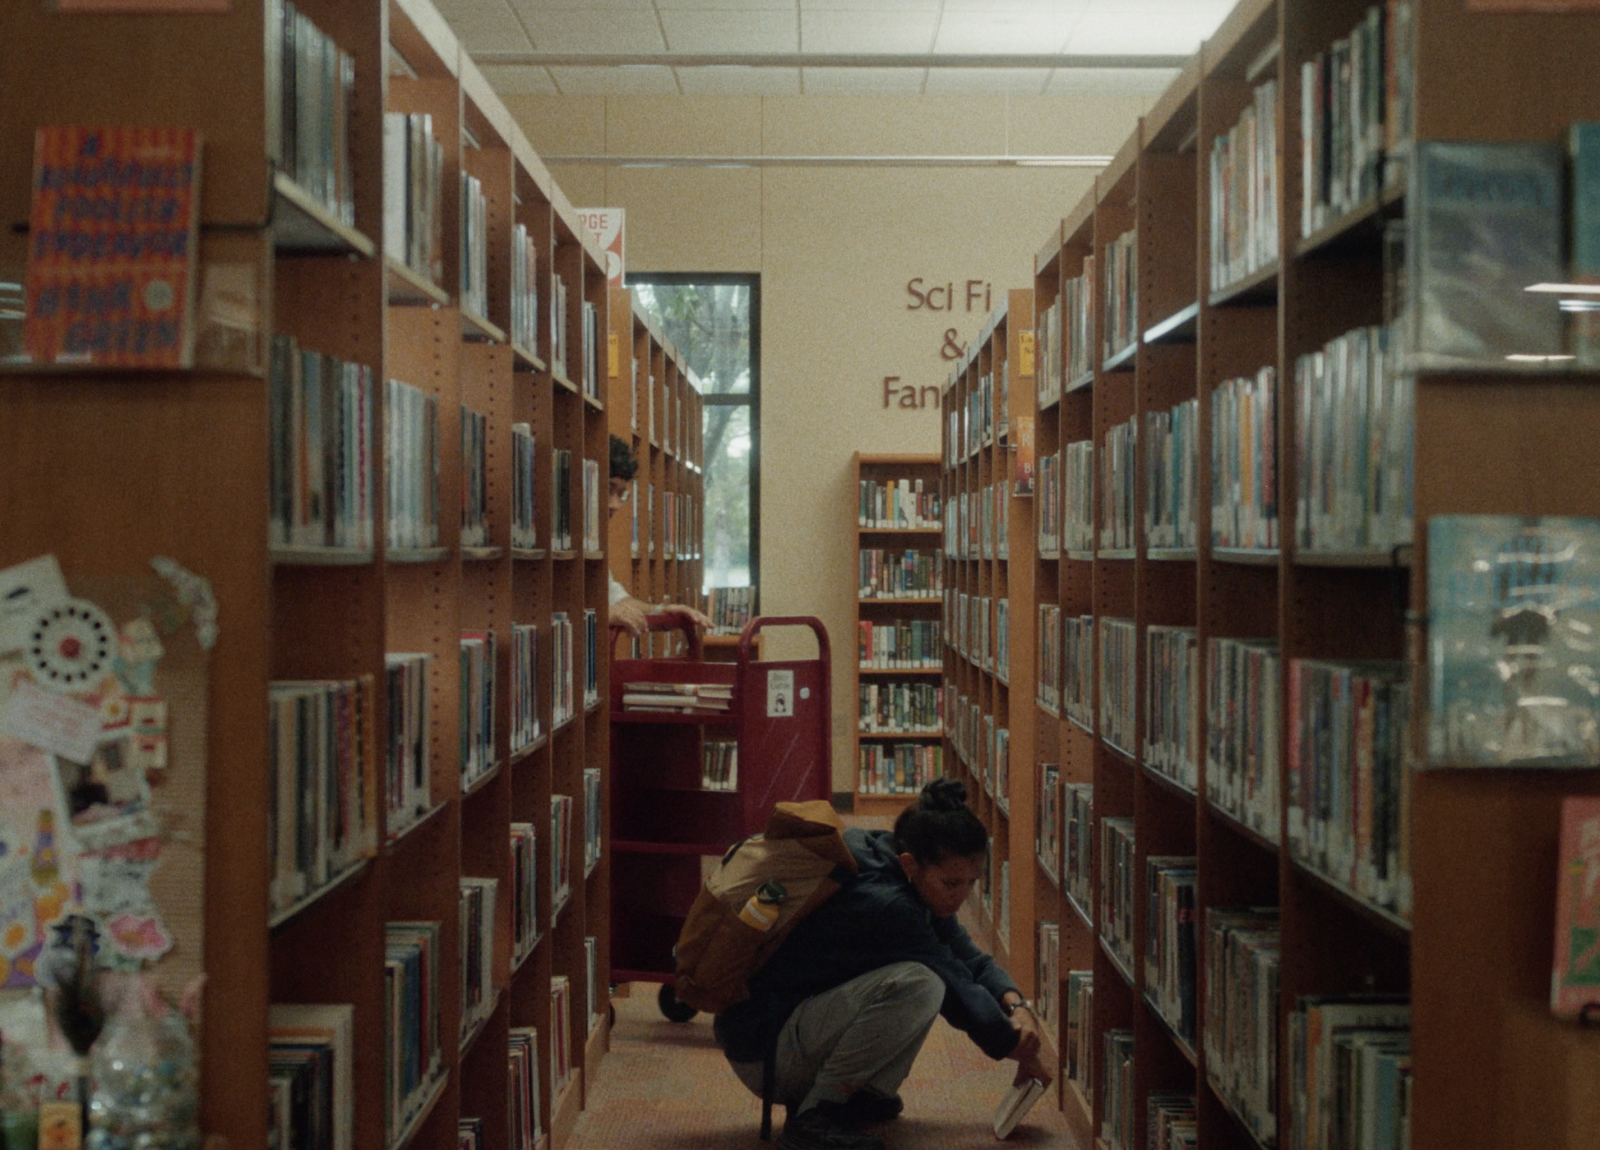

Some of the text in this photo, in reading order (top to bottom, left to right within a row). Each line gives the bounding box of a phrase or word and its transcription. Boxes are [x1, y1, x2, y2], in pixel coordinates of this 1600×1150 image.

[907, 277, 992, 312] Sci Fi
[940, 327, 967, 361] &
[883, 376, 940, 410] Fan
